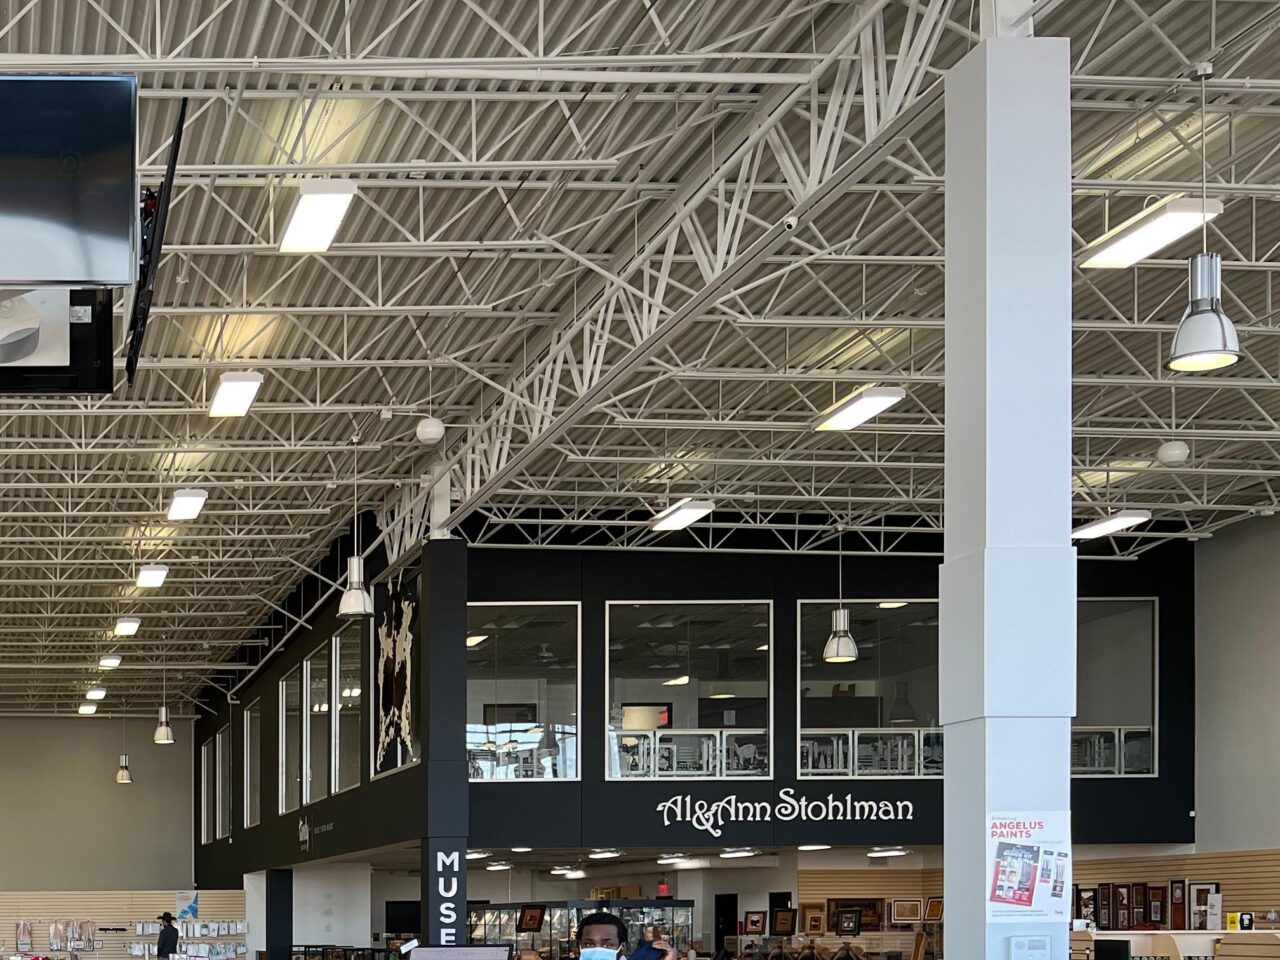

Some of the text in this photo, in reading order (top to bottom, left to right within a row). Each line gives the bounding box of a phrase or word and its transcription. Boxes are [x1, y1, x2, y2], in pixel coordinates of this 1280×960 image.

[990, 821, 1045, 830] ANGELUS
[991, 830, 1032, 839] PAINTS
[437, 851, 460, 946] MUSE
